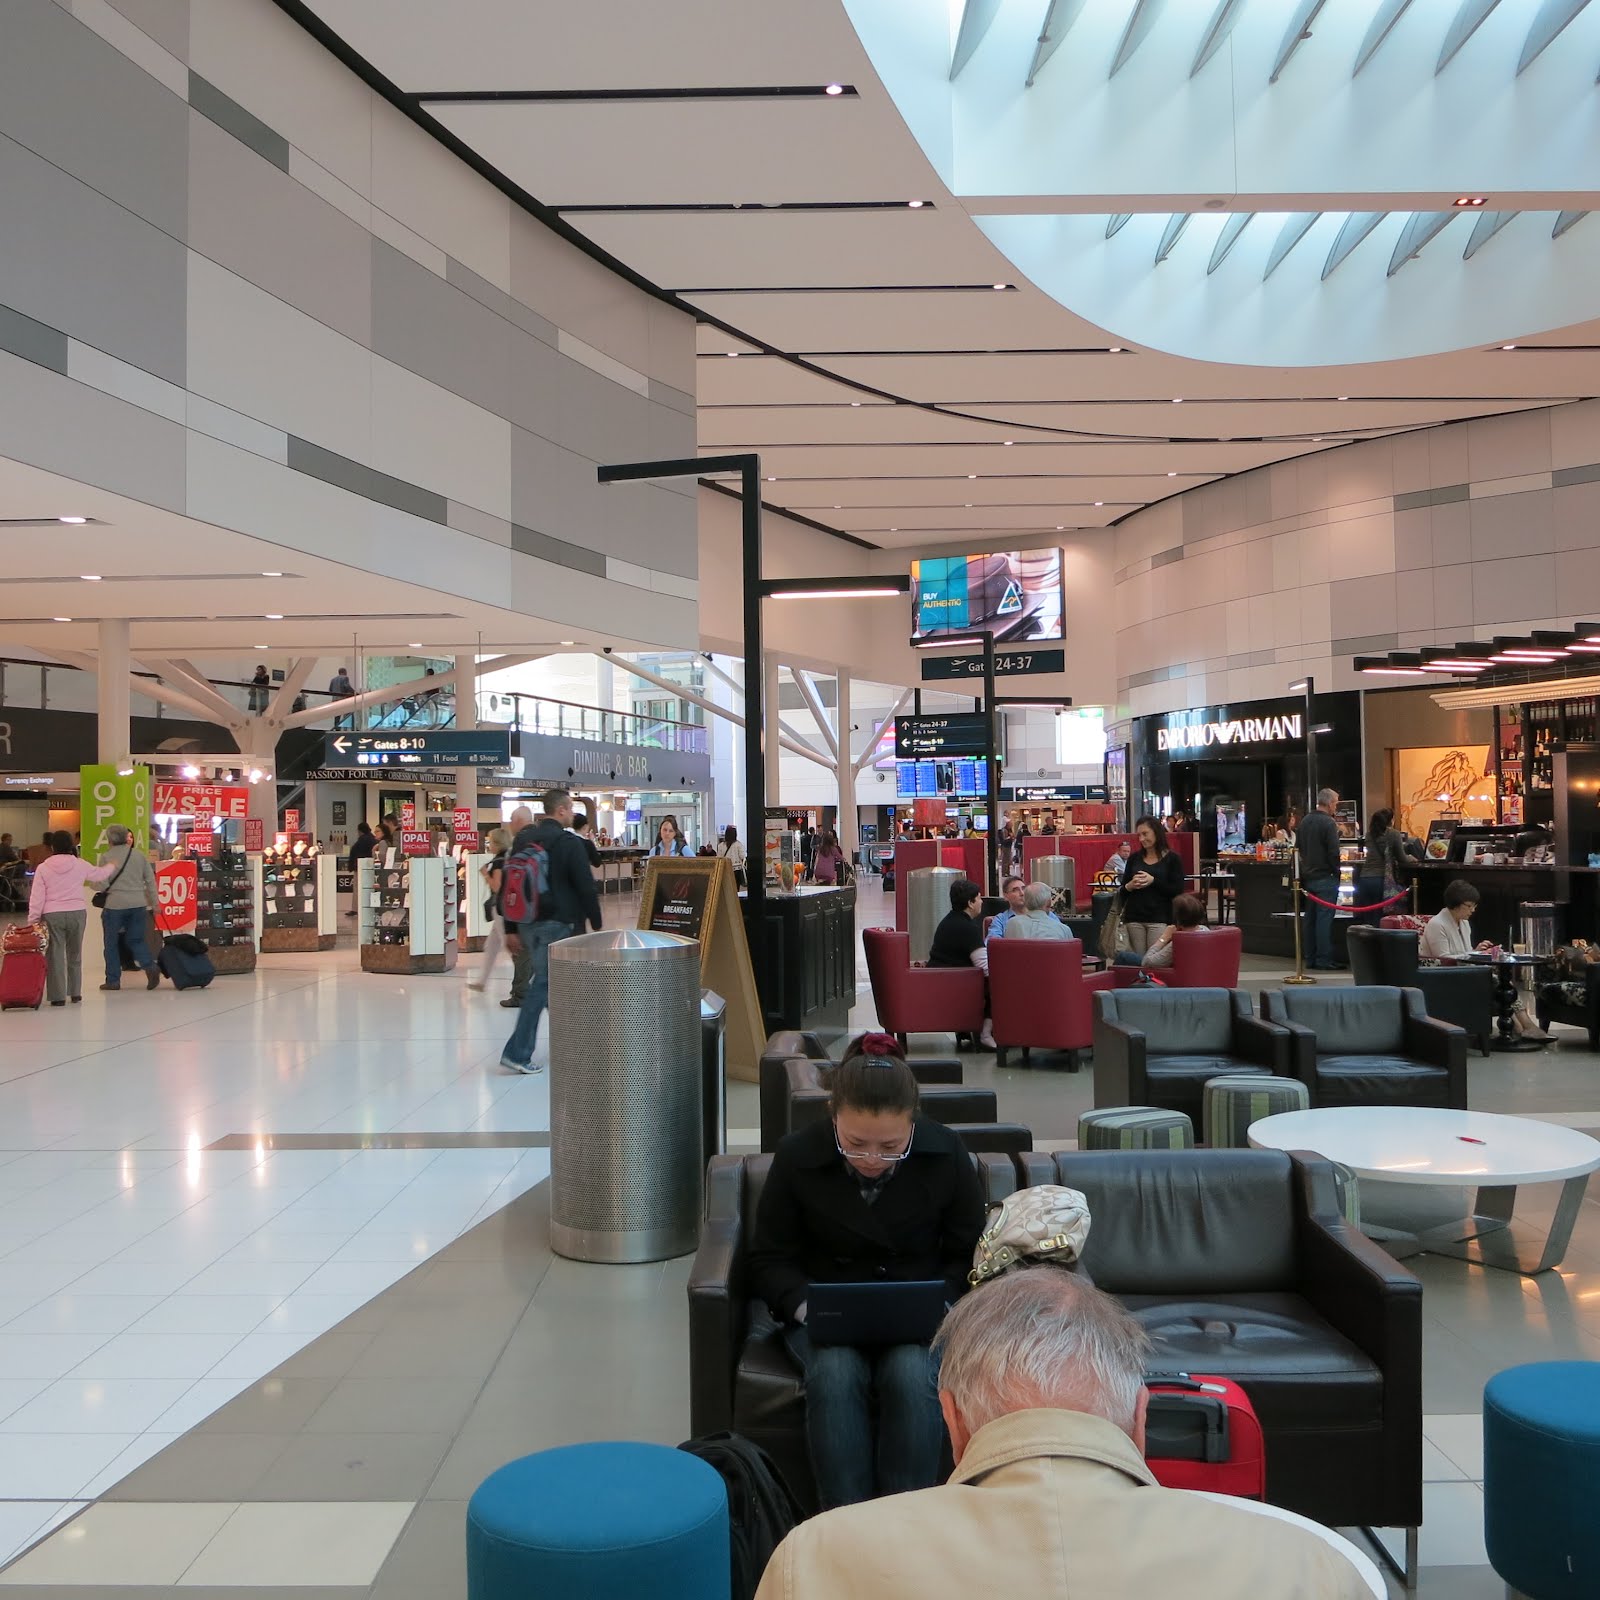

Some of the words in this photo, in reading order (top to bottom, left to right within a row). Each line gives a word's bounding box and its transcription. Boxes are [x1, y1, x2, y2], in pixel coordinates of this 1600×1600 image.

[923, 592, 938, 600] BUY
[923, 599, 962, 608] AUTHENTIC
[968, 662, 985, 672] Gat
[995, 655, 1032, 670] 24-37
[1157, 723, 1215, 751] EMPORIO
[1233, 714, 1302, 743] ARMANI
[374, 740, 399, 750] Gates
[399, 737, 425, 750] 8-10
[399, 754, 421, 763] Toilets
[479, 755, 499, 763] Shops
[573, 749, 611, 776] DINING
[615, 753, 623, 776] &
[628, 755, 648, 778] BAR
[5, 777, 29, 785] Currency
[30, 776, 54, 785] Exchange
[306, 770, 345, 780] PASSION
[348, 770, 368, 779] FOR
[370, 771, 383, 779] LIFE
[388, 771, 418, 781] OBSESSION
[420, 774, 435, 782] WITH
[183, 787, 222, 795] PRICE
[180, 796, 246, 817] SALE
[455, 820, 470, 828] off!
[403, 833, 430, 843] OPAL
[455, 833, 477, 841] OPAL
[188, 843, 212, 852] SALE
[158, 875, 195, 904] 50%
[164, 906, 186, 916] OFF
[663, 905, 693, 915] BREAKFAST
